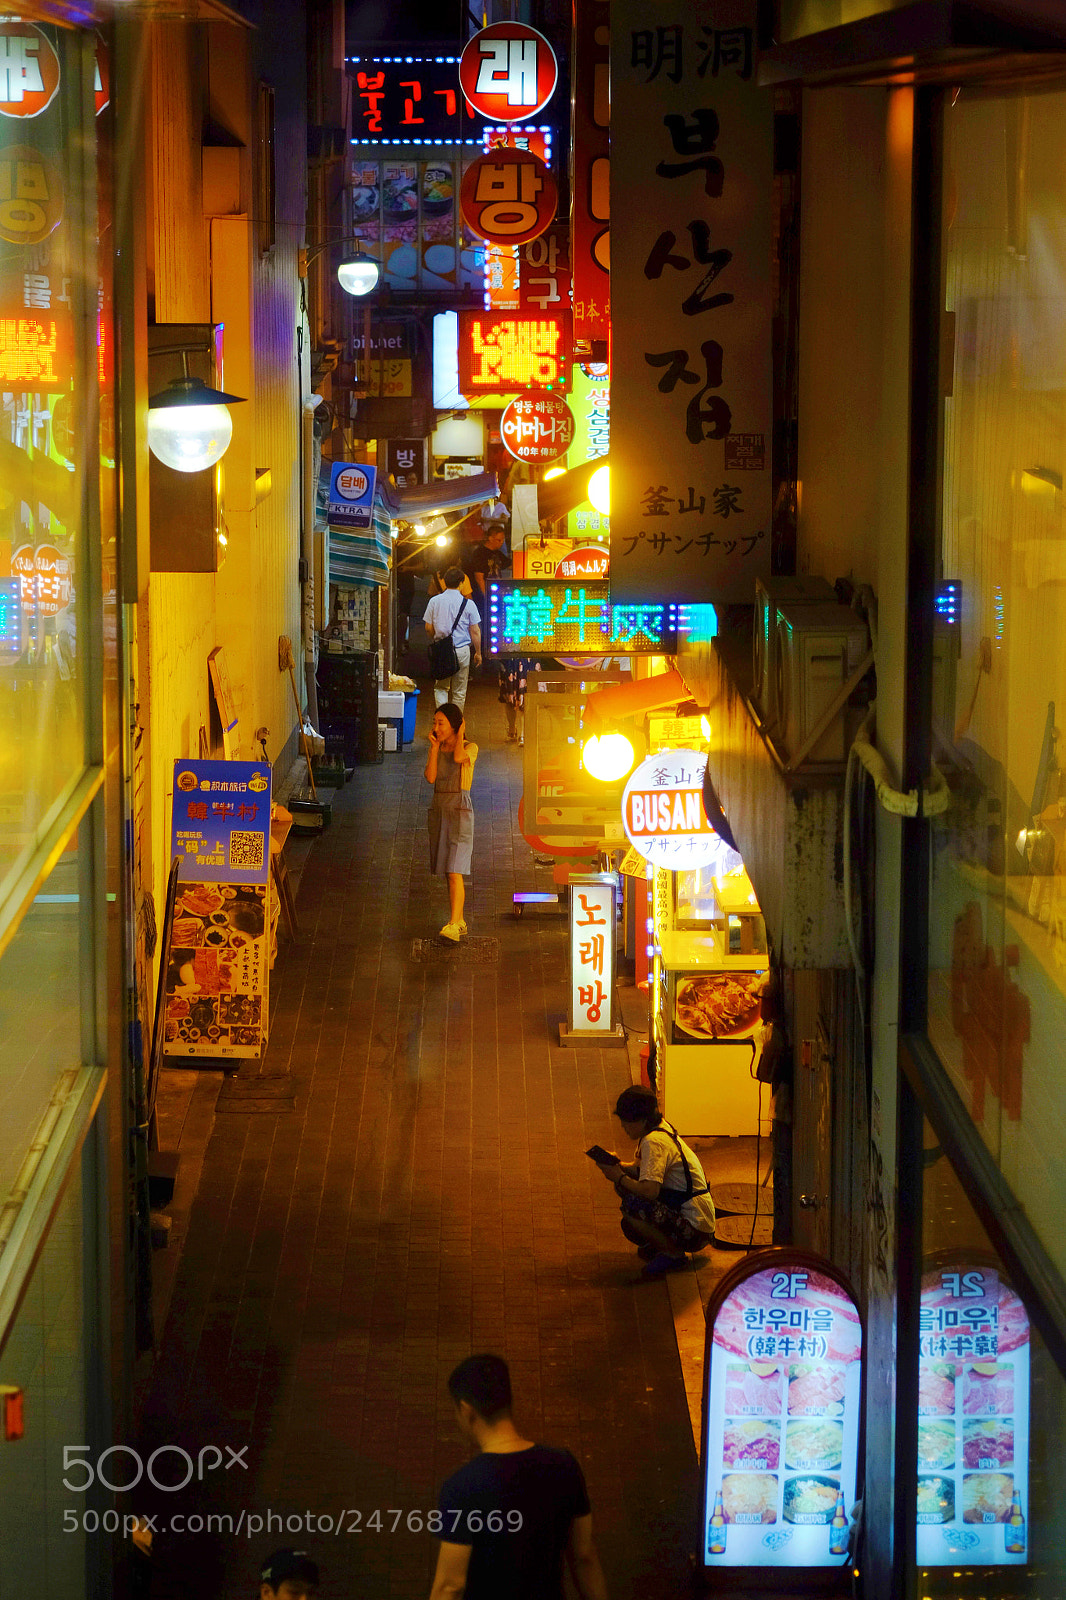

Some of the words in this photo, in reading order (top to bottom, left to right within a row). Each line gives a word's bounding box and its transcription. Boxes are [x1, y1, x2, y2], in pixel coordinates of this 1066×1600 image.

[630, 24, 753, 84] 明洞
[475, 39, 538, 106] 래
[356, 71, 476, 132] 불고기
[475, 163, 543, 235] 방
[643, 108, 733, 444] 부산집
[513, 400, 534, 414] 명동
[504, 415, 572, 443] 어머니집
[517, 446, 539, 457] 40年
[340, 475, 365, 490] 담배
[640, 484, 744, 519] 釜山家
[622, 530, 765, 556] プサンチップ
[631, 792, 701, 832] BUSAN
[575, 893, 608, 1023] 노래방
[771, 1272, 808, 1299] 2F
[743, 1307, 834, 1331] 한우마을
[747, 1335, 827, 1358] (韓牛村)
